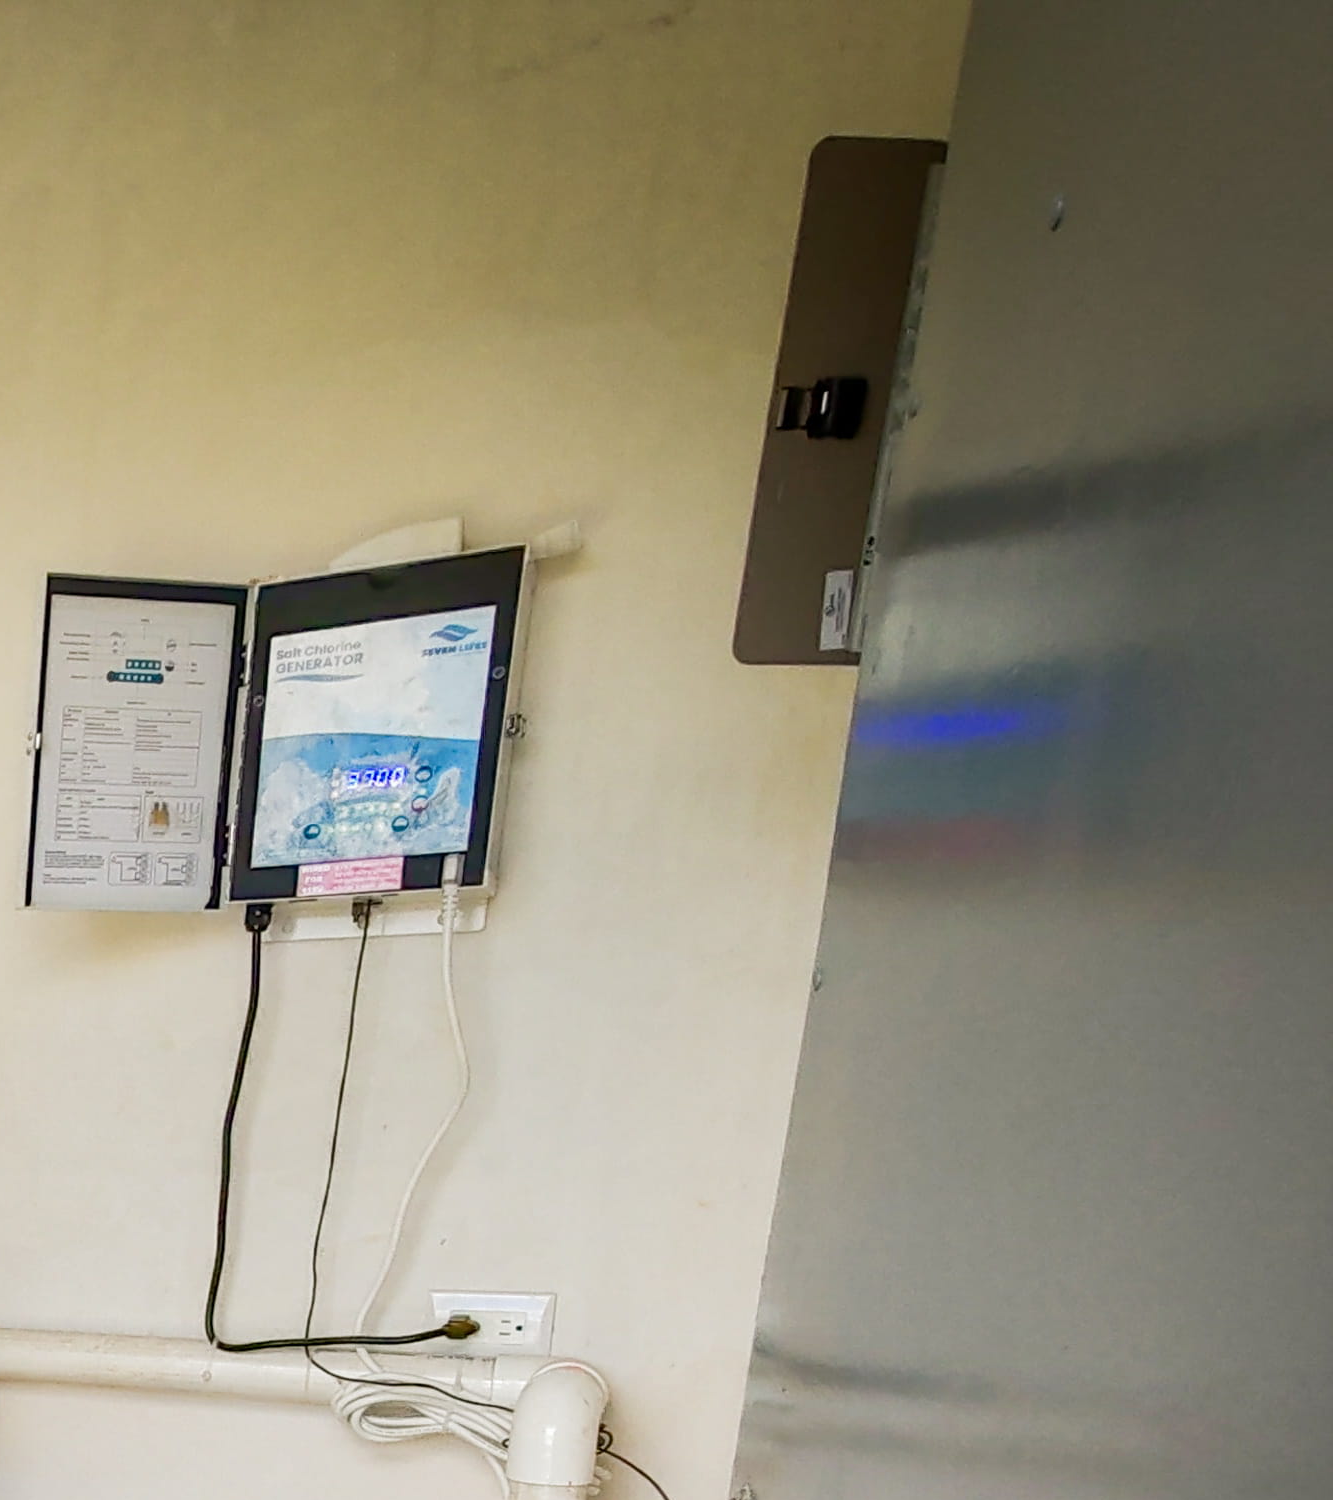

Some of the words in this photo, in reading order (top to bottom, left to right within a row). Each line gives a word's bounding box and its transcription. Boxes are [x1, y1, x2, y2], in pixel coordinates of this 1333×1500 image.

[276, 646, 303, 661] Salt
[304, 640, 361, 656] Chlorine
[276, 653, 364, 674] GENERATOR
